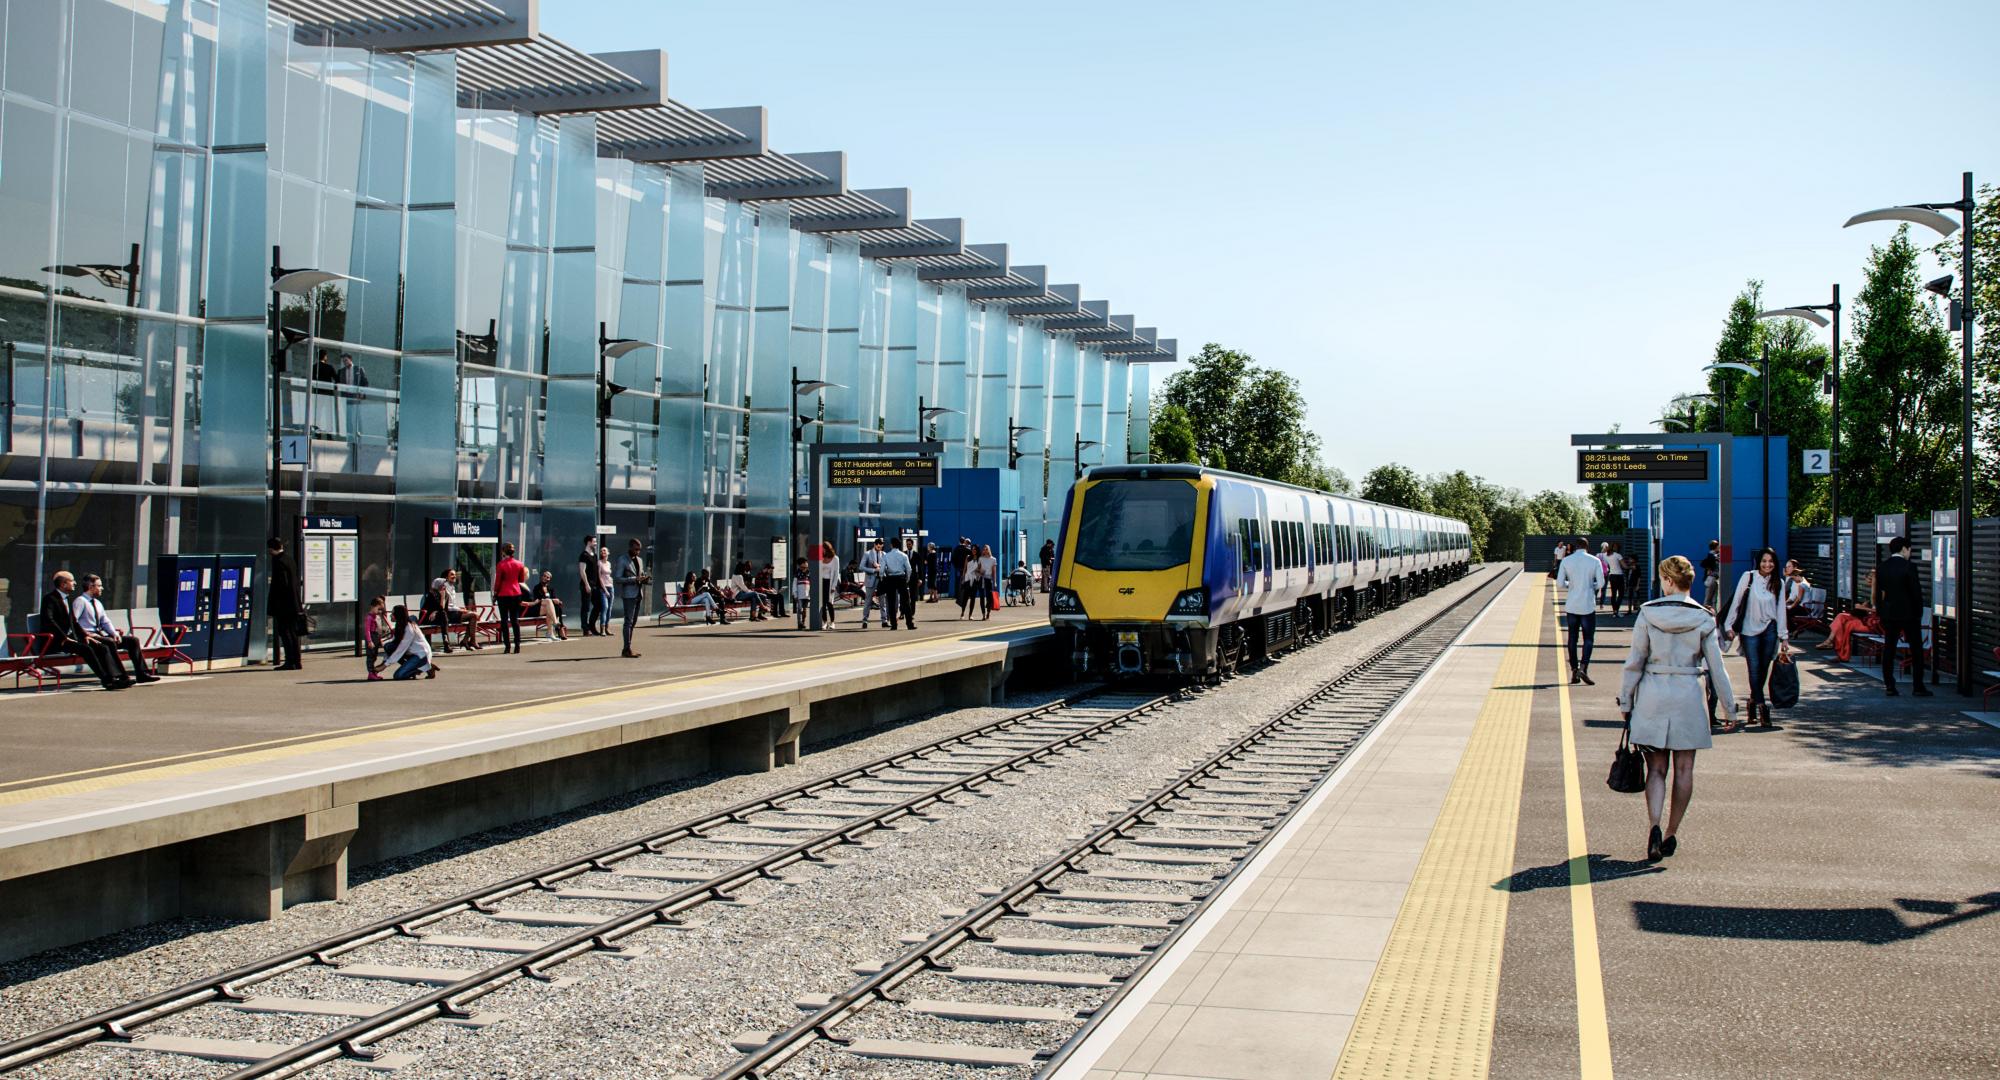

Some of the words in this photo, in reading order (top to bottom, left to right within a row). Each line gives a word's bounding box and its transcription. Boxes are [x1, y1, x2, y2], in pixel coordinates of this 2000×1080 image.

[289, 440, 297, 460] 1
[1811, 453, 1822, 470] 2
[319, 518, 331, 528] White
[452, 521, 467, 535] White
[467, 521, 480, 535] Rose
[1118, 587, 1136, 595] CAF
